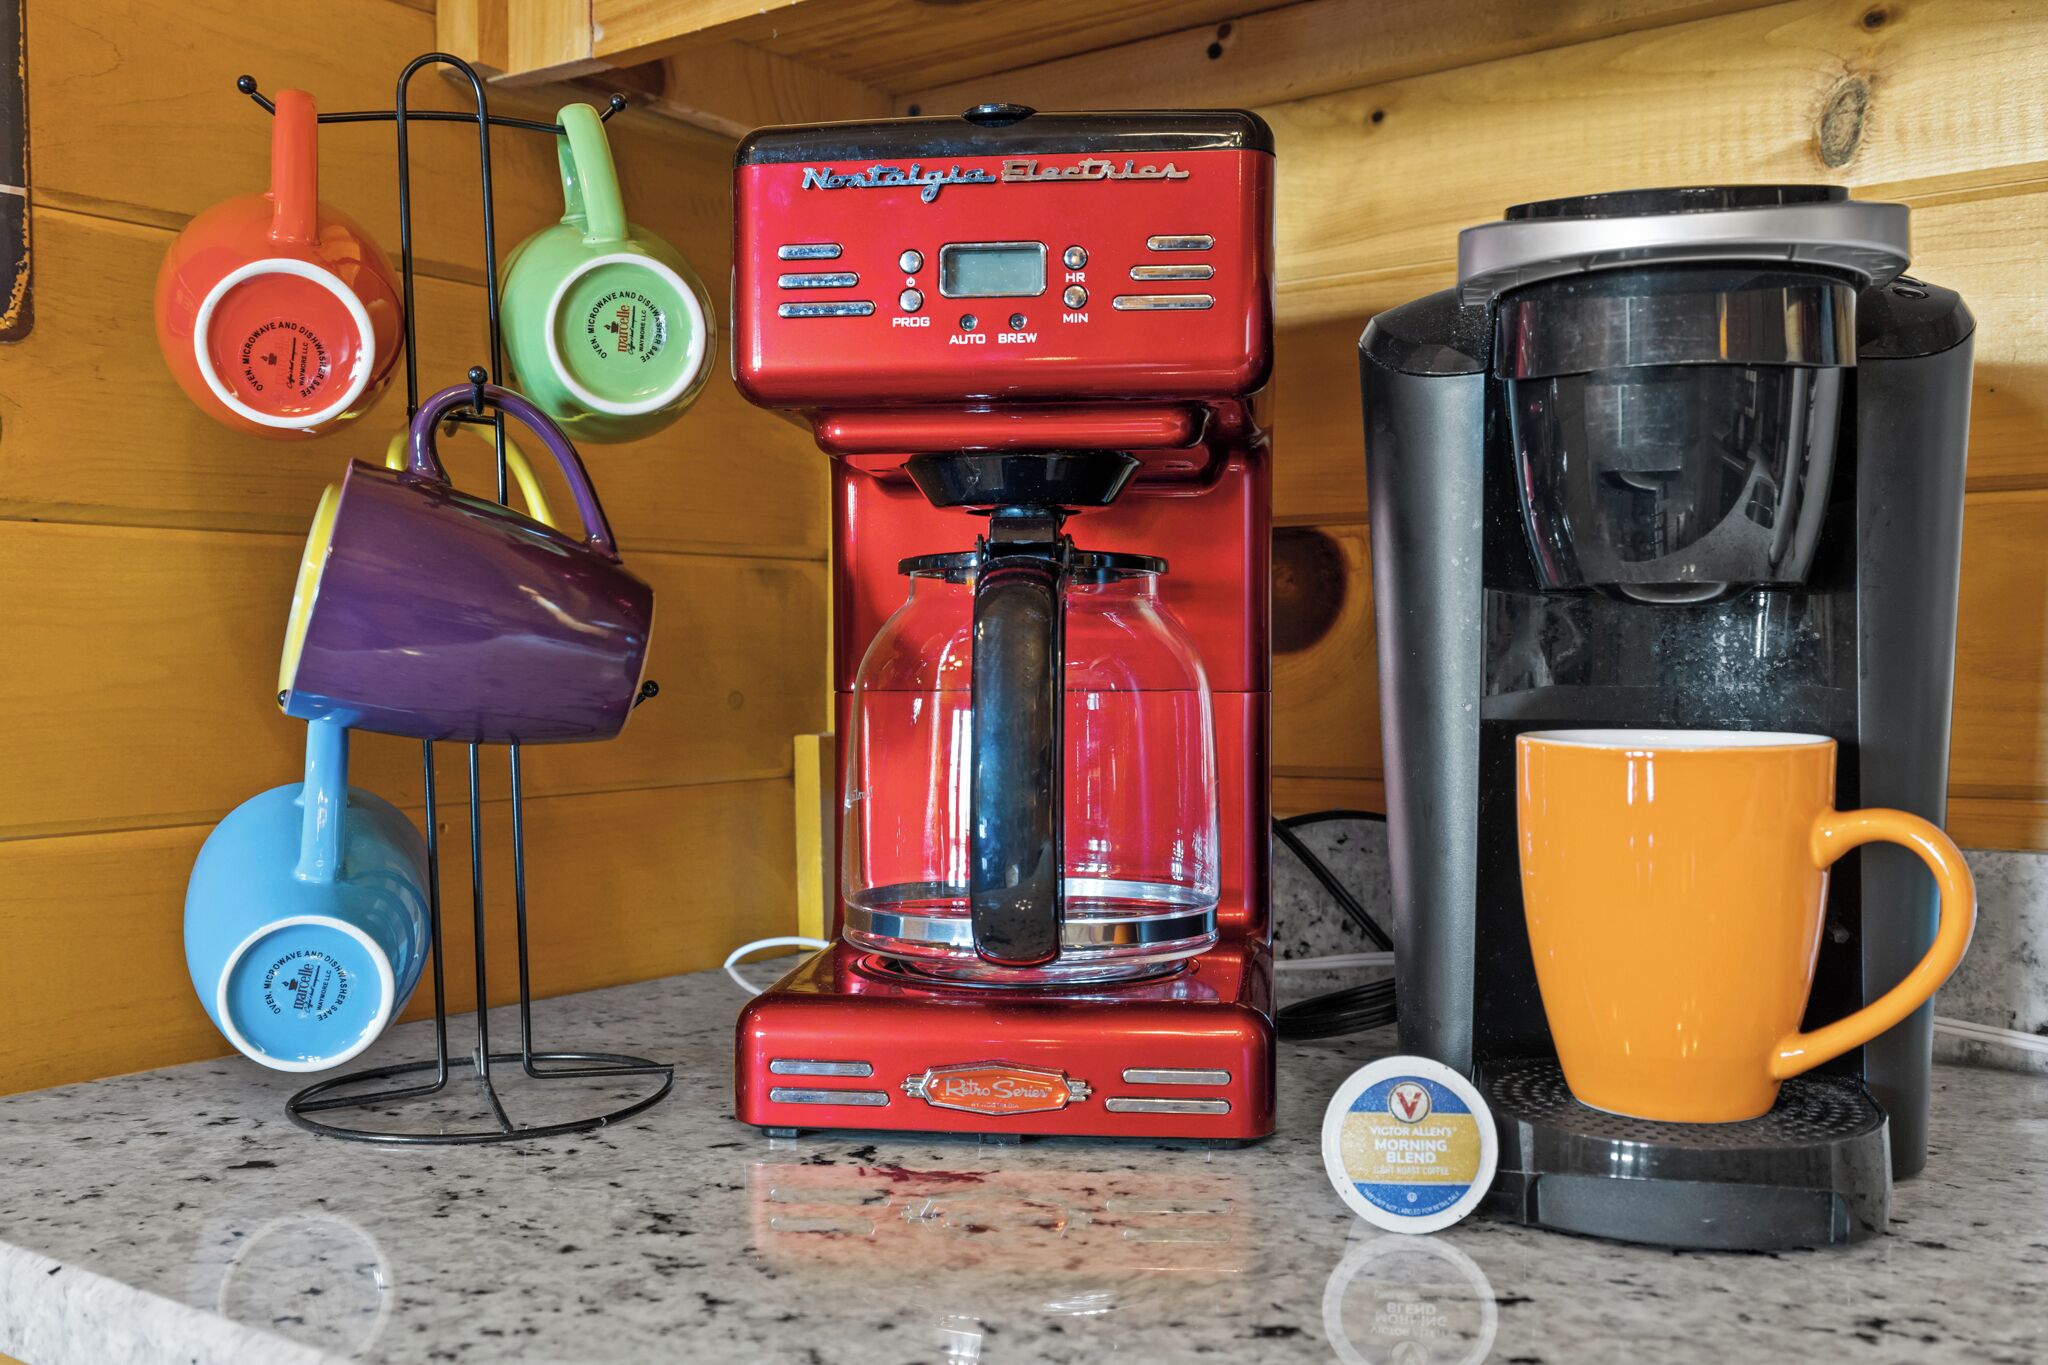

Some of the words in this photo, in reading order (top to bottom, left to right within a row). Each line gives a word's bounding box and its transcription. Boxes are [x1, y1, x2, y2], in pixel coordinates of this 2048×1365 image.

[801, 163, 998, 204] Nostalgia
[1000, 157, 1191, 183] Electrics
[1065, 272, 1086, 283] HR
[618, 290, 637, 299] AND
[587, 292, 618, 334] MICROWAVE
[637, 295, 663, 345] DISHWASHER
[892, 316, 930, 328] PROG
[1062, 313, 1089, 324] MIN
[278, 321, 297, 331] AND
[616, 304, 630, 352] marcelle
[242, 322, 277, 365] MICROWAVE
[639, 322, 647, 352] WAYMORE
[949, 333, 986, 345] AUTO
[998, 332, 1038, 344] BREW
[299, 326, 327, 380] DISHWASHER
[640, 345, 658, 363] SAFE
[299, 354, 307, 386] WAYMORE
[300, 379, 320, 398] SAFE
[304, 950, 323, 959] AND
[263, 950, 302, 989] MICROWAVE
[293, 963, 315, 1010] marcelle
[324, 955, 348, 1005] DISHWASHER
[316, 981, 329, 1011] WAYMORE
[324, 969, 332, 982] LLC
[316, 1004, 338, 1022] SAFE
[944, 1077, 991, 1098] Retro
[1396, 1092, 1422, 1119] V
[1370, 1126, 1409, 1136] VICTOR
[1375, 1139, 1447, 1152] MORNING
[1386, 1152, 1436, 1163] BLEND
[1422, 1167, 1449, 1175] COFFEE
